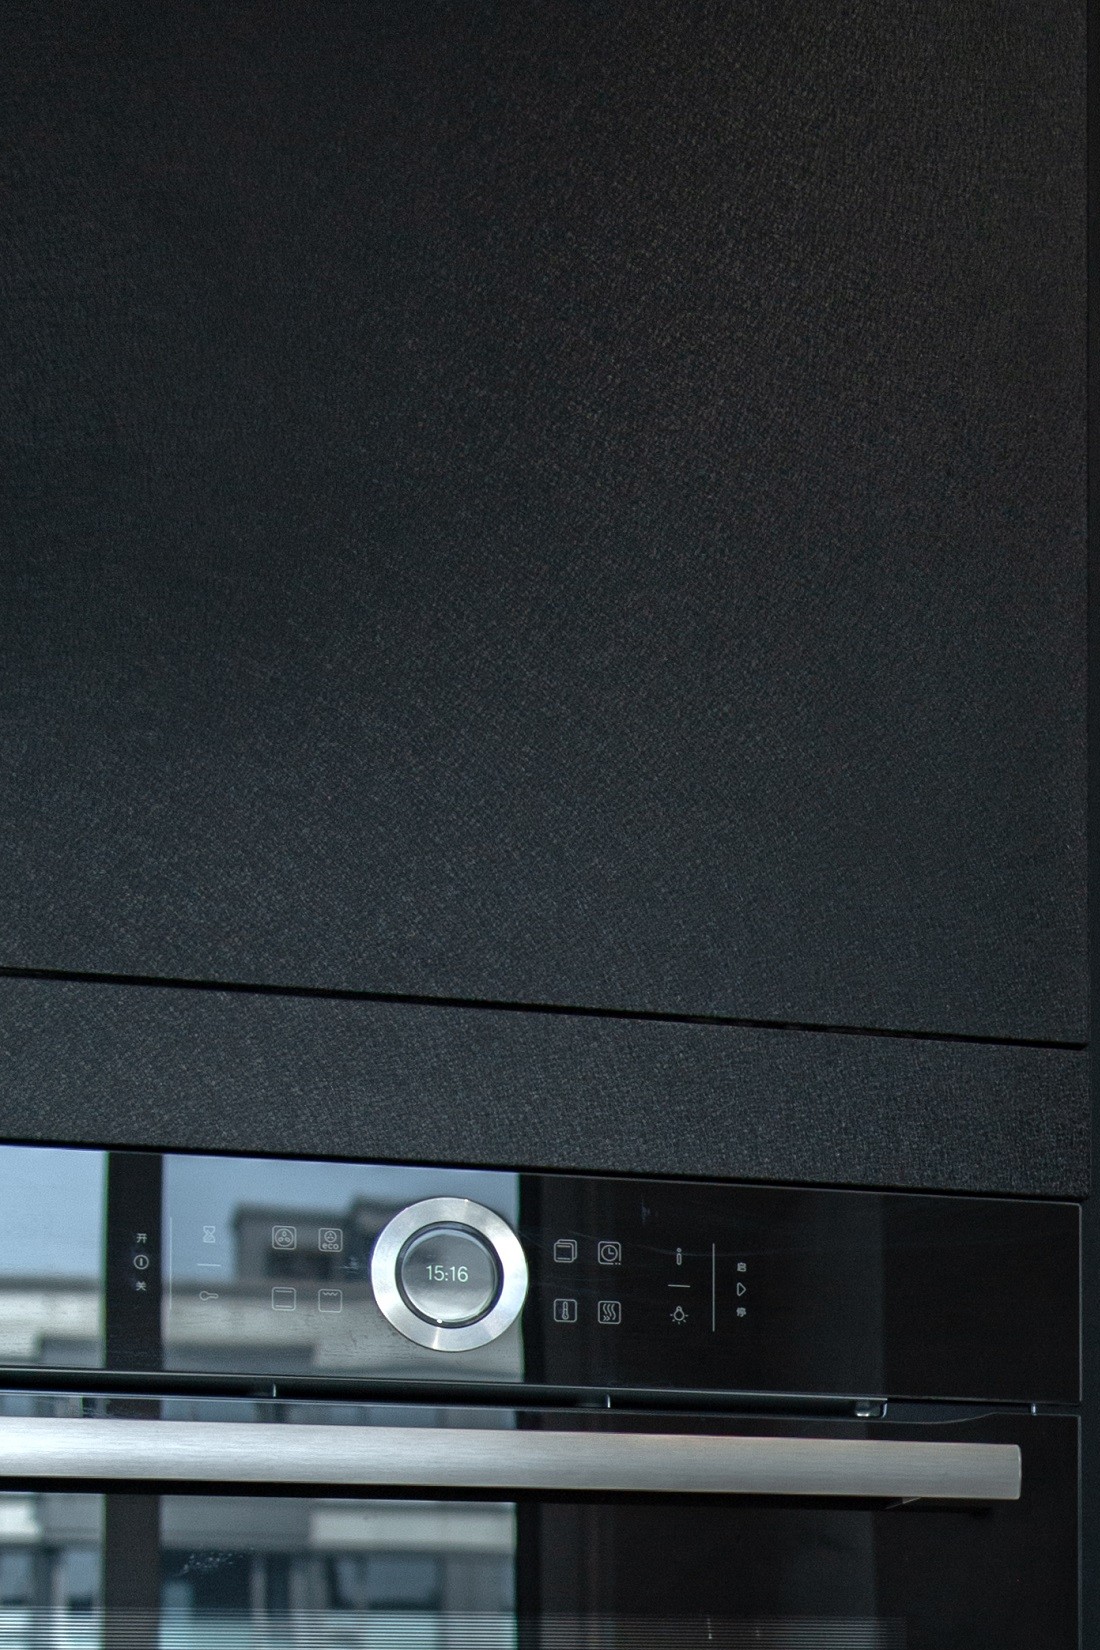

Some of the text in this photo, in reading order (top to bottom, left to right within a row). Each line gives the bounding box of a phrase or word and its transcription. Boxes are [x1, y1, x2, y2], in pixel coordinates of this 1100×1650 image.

[136, 1232, 148, 1244] 开
[321, 1242, 339, 1250] eco
[426, 1265, 469, 1283] 15:16
[135, 1280, 147, 1291] 关
